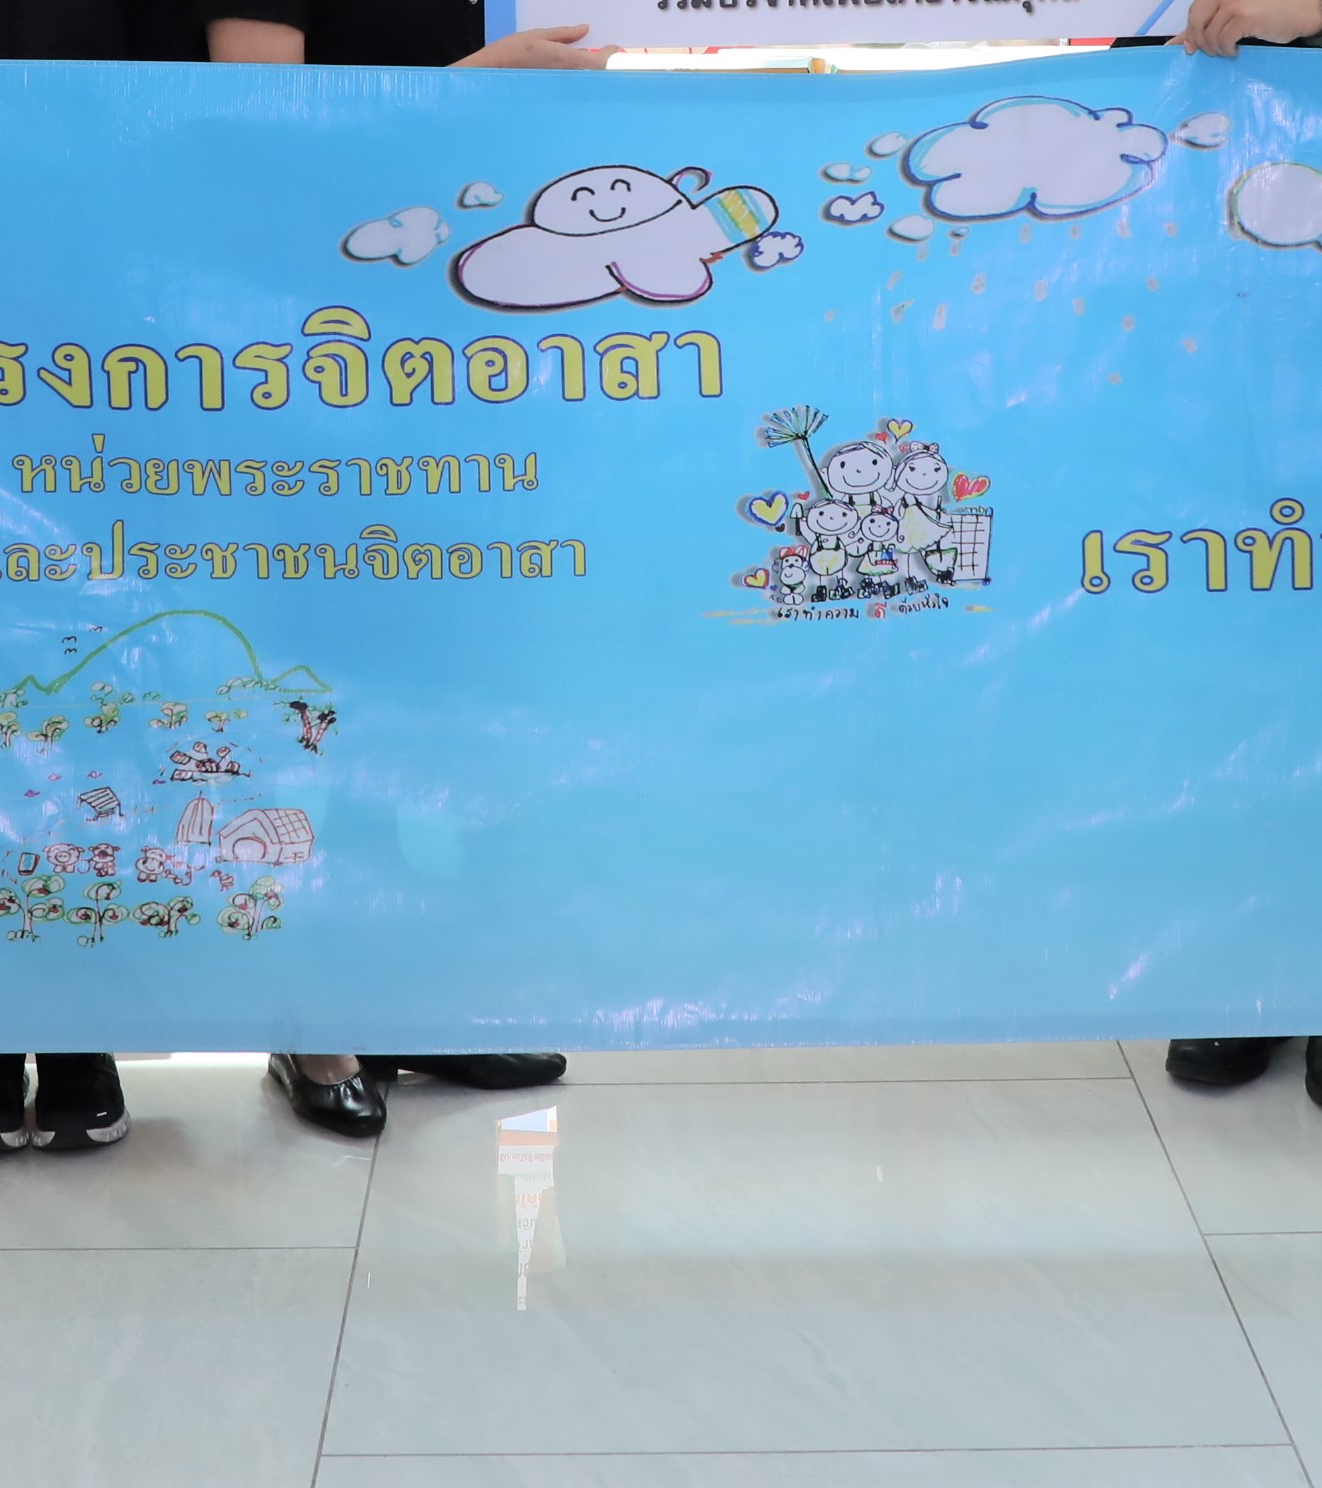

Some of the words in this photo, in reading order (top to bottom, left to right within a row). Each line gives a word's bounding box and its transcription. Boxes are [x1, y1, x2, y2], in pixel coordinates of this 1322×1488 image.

[12, 433, 539, 497] หน่วยพระราชทาน
